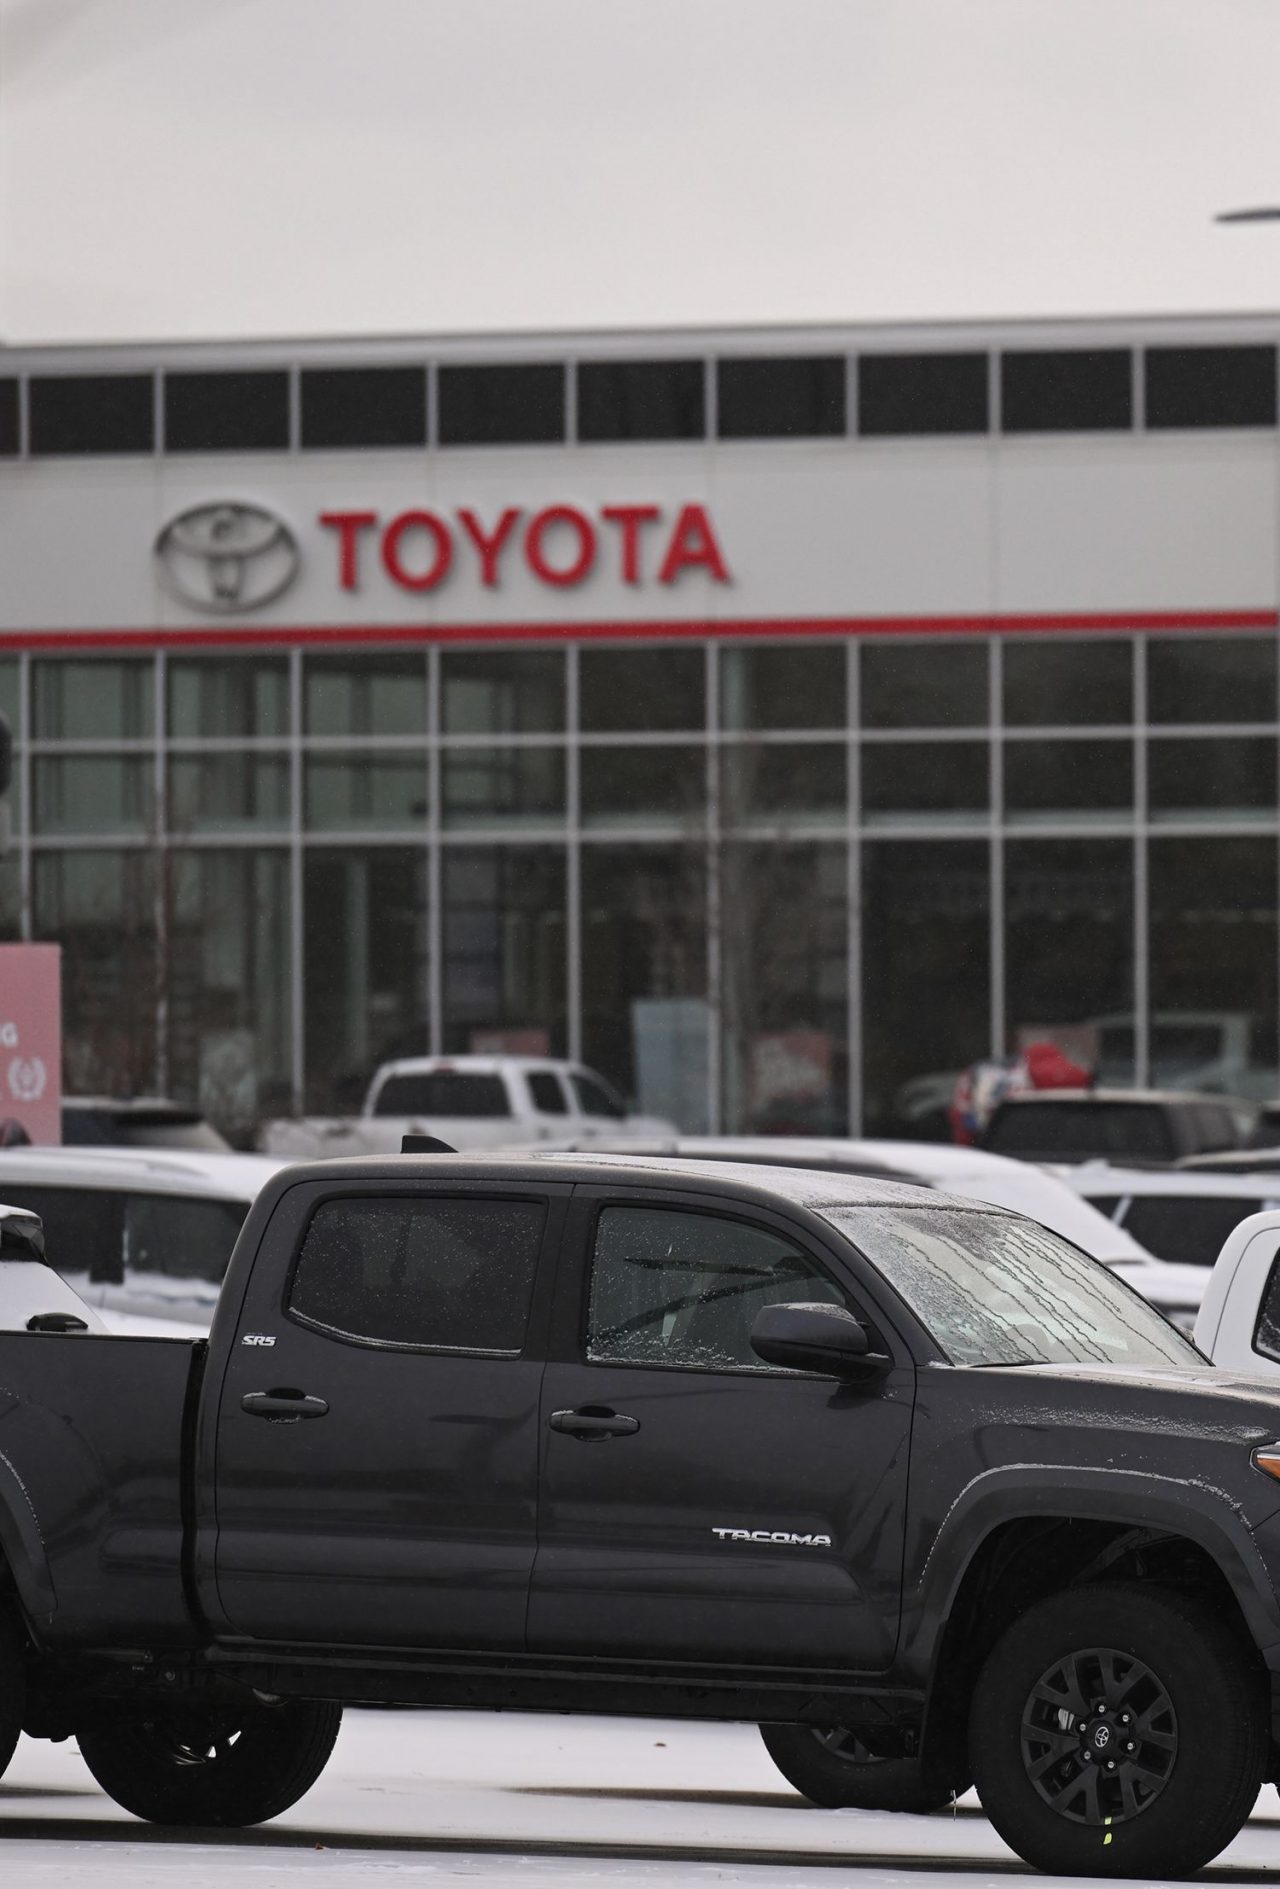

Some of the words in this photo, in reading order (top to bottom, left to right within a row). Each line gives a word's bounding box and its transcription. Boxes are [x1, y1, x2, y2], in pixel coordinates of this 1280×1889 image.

[319, 503, 730, 592] TOYOTA
[241, 1335, 277, 1346] SR5
[711, 1527, 832, 1547] TACOMA
